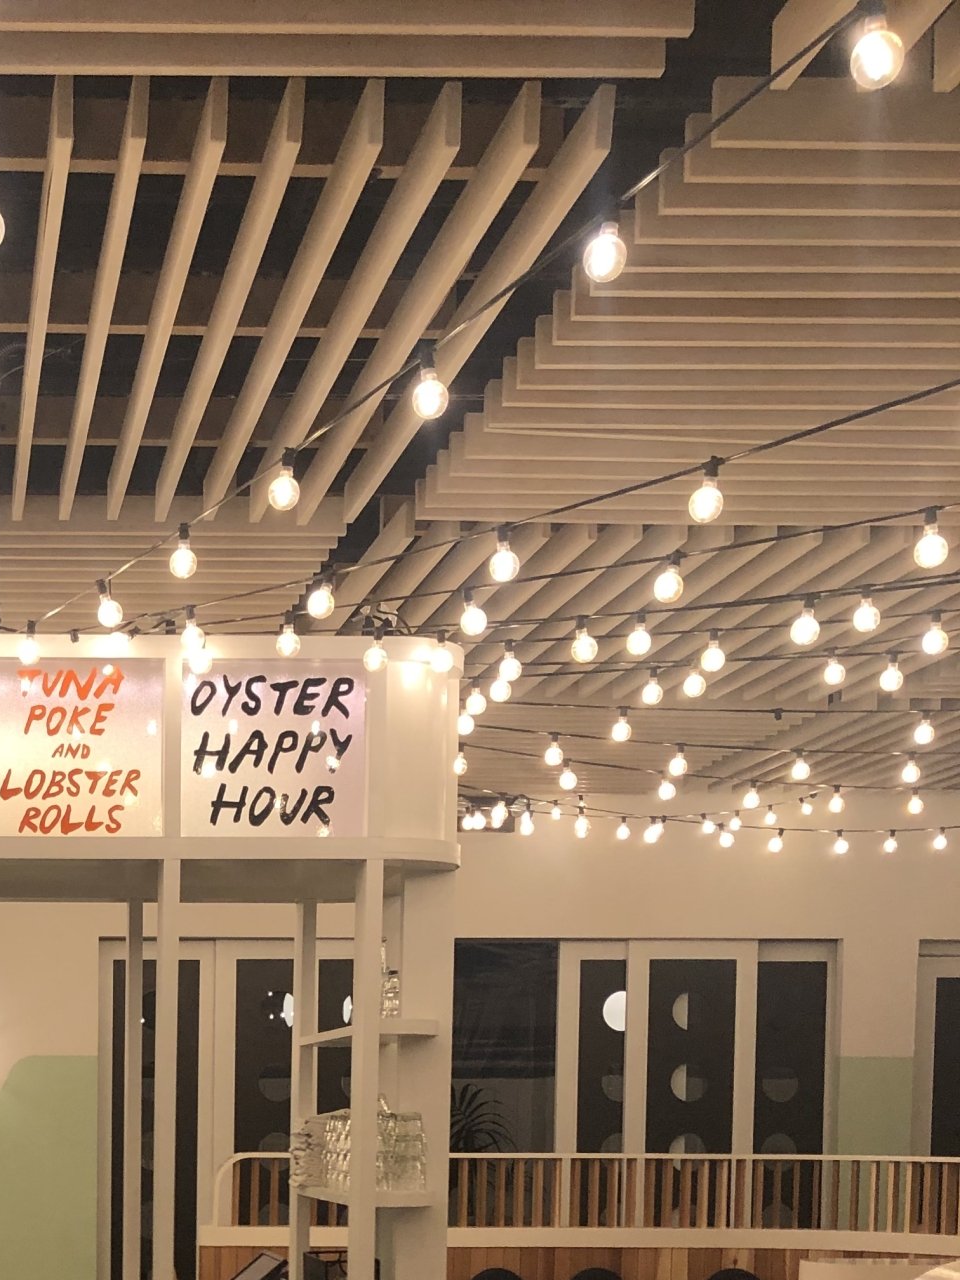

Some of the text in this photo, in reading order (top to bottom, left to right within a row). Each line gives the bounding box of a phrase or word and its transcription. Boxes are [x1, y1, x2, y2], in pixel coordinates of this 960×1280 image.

[17, 666, 125, 700] TUNA
[190, 674, 355, 719] OYSTER
[24, 702, 115, 737] POKE
[52, 742, 91, 760] AND
[193, 730, 353, 775] HAPPY
[0, 768, 141, 801] LOBSTER
[18, 804, 125, 835] ROLLS
[209, 782, 335, 827] HOUR
